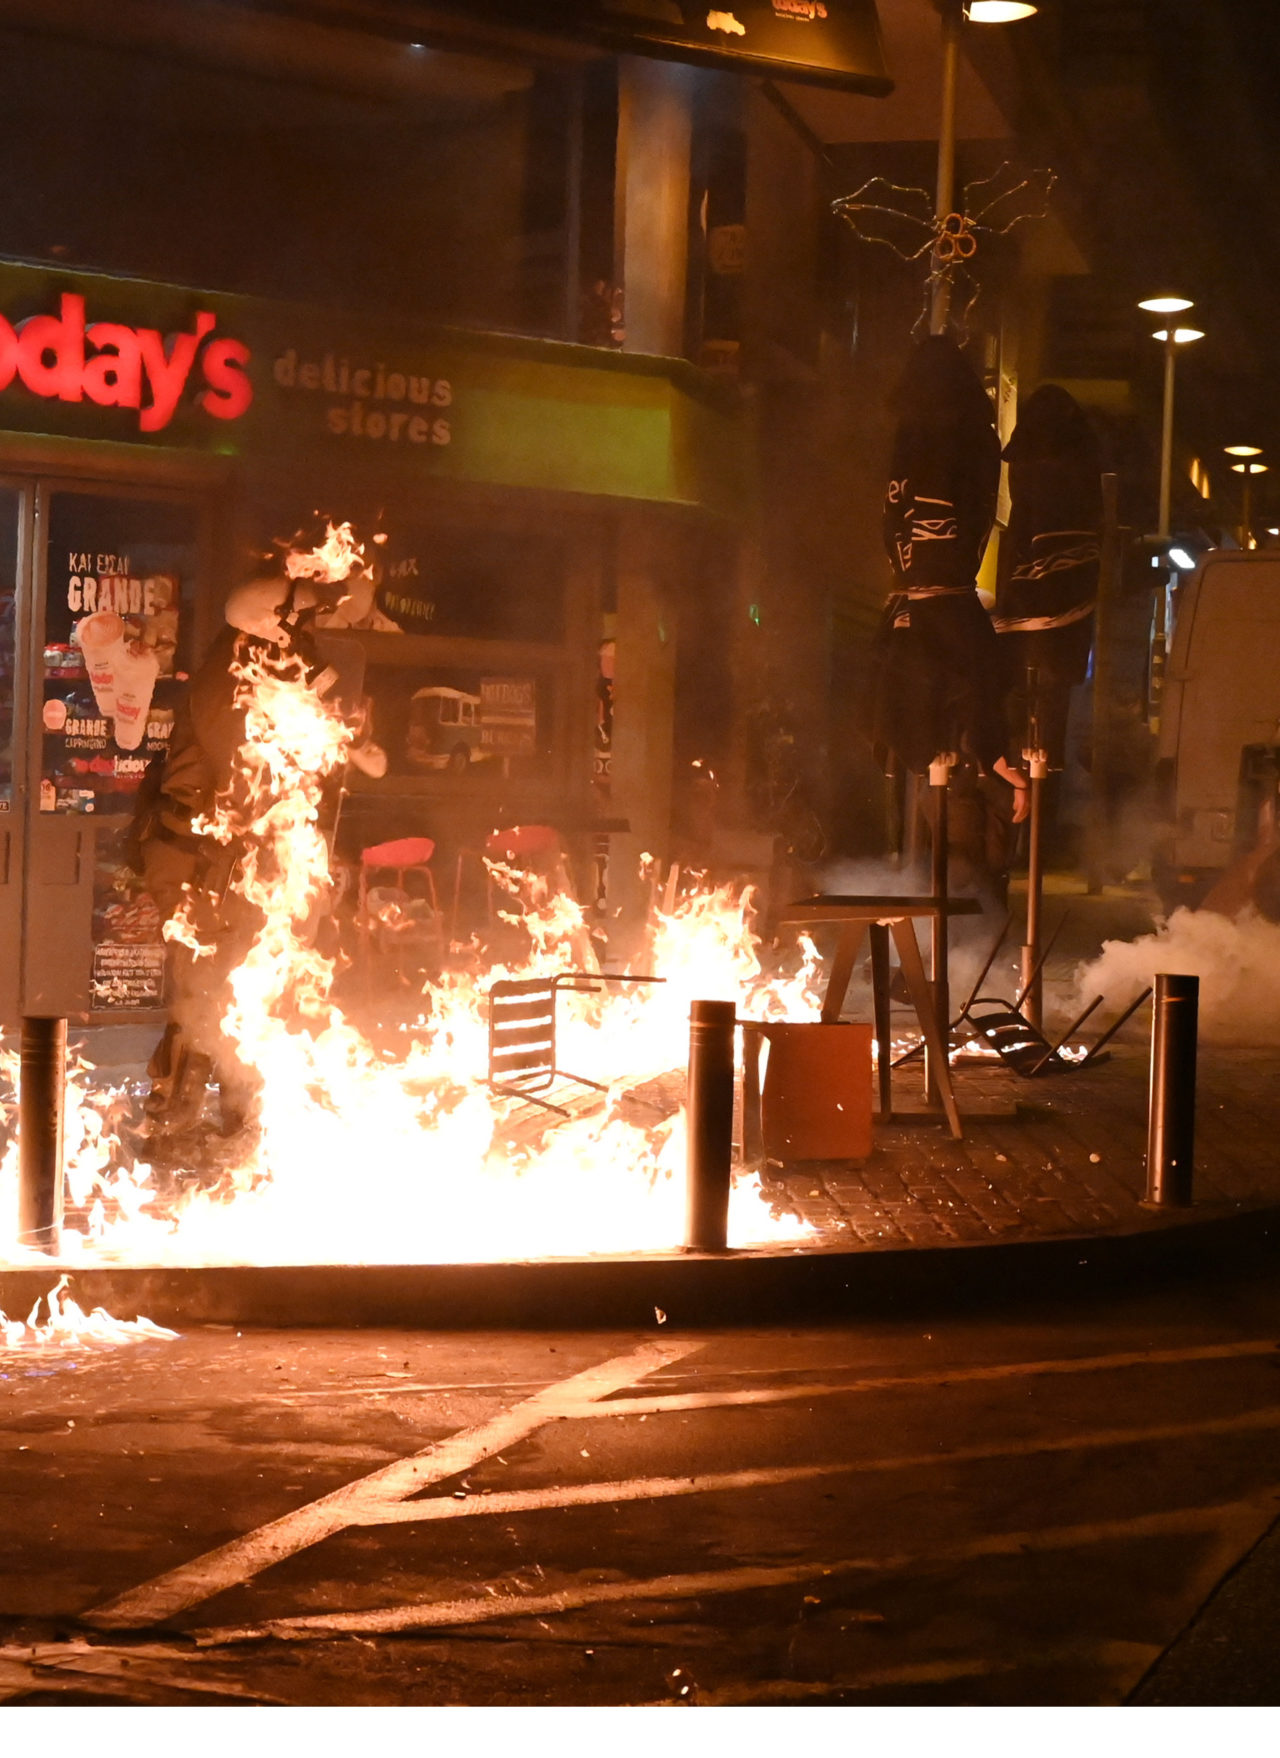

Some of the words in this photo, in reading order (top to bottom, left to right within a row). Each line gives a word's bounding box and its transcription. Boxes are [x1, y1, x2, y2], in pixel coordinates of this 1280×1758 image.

[273, 348, 452, 407] delicious
[328, 401, 451, 445] stores
[67, 575, 156, 616] GRANDE
[65, 718, 107, 736] GRANDE
